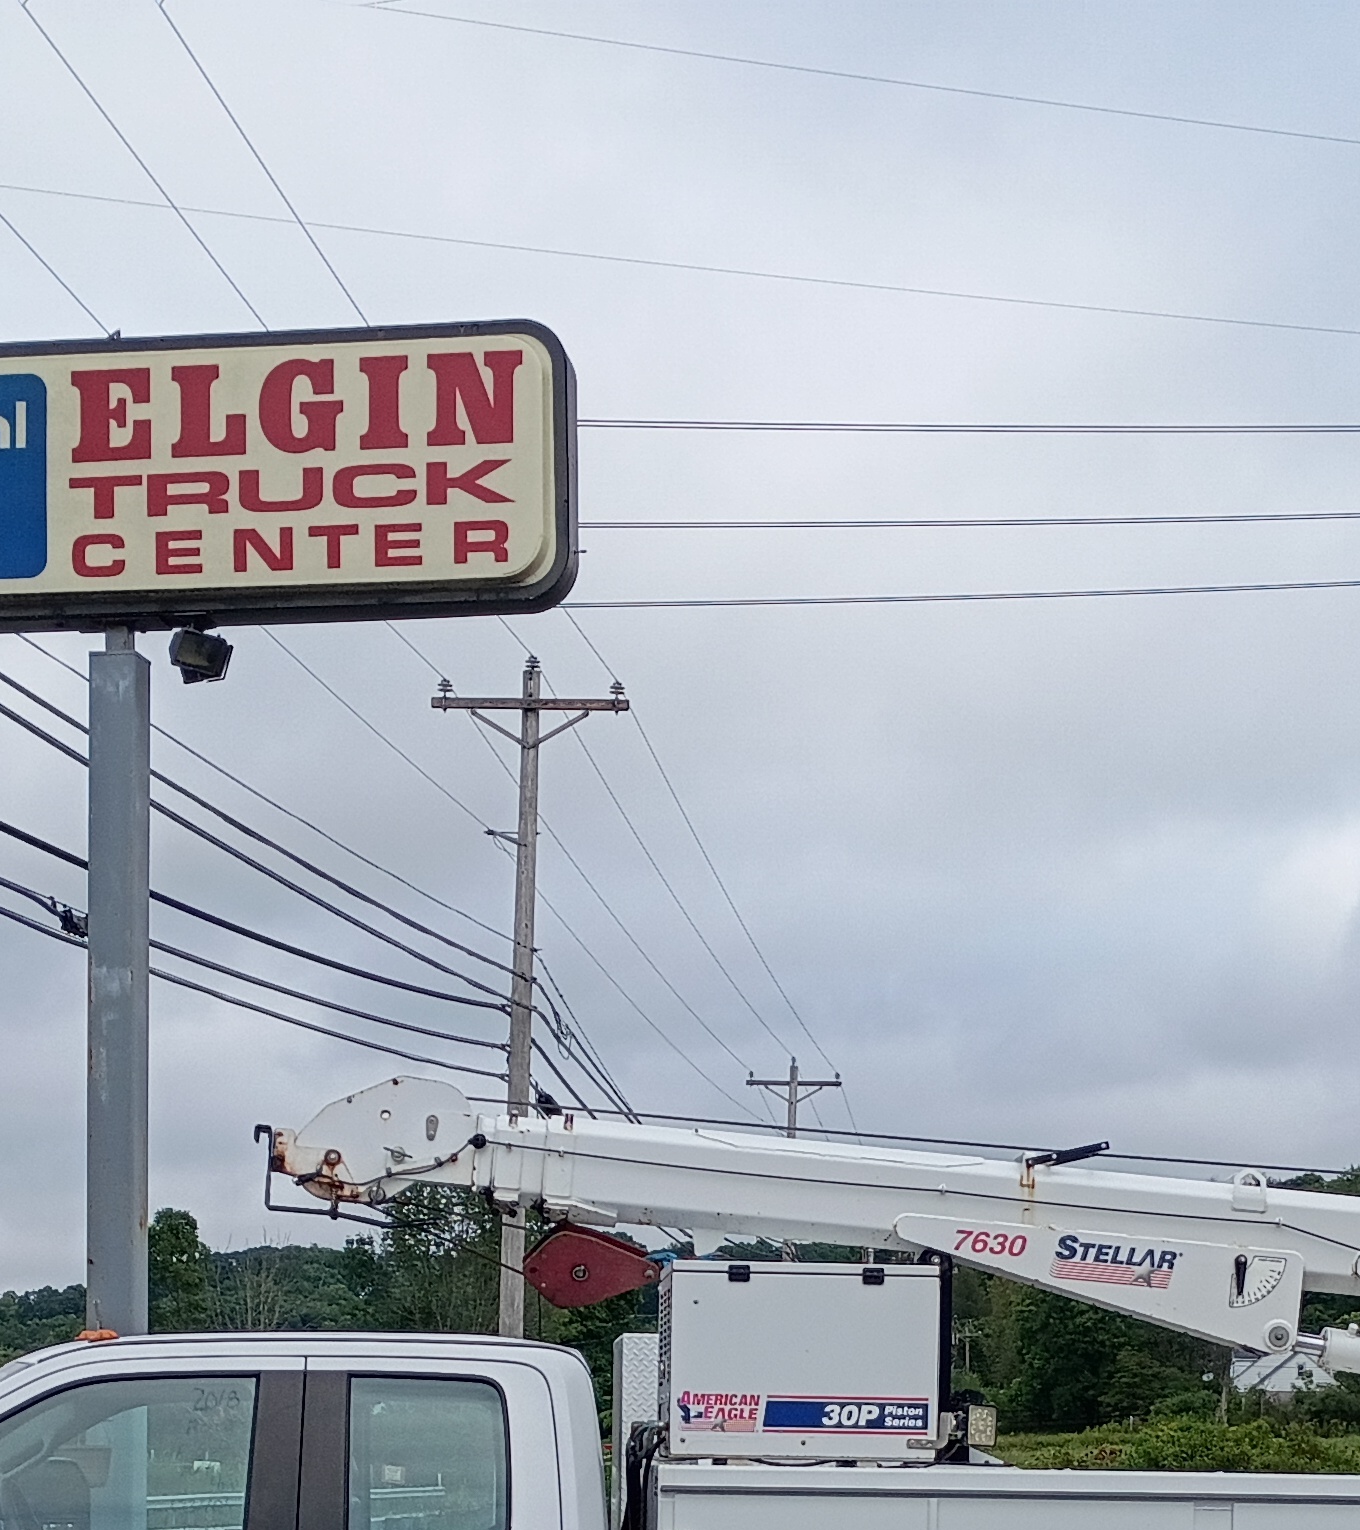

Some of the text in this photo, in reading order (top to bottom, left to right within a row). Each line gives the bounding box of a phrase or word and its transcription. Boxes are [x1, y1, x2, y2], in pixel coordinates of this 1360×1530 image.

[70, 349, 524, 464] ELGIN
[68, 457, 517, 519] TRUCK
[71, 519, 511, 579] CENTER
[953, 1229, 1028, 1257] 7630
[1054, 1234, 1179, 1270] STELLAR
[193, 1387, 240, 1412] 2018
[681, 1390, 761, 1407] AMERICAN
[703, 1405, 759, 1420] EAGLE
[821, 1404, 924, 1427] 30P Piston
[883, 1415, 924, 1428] Series
